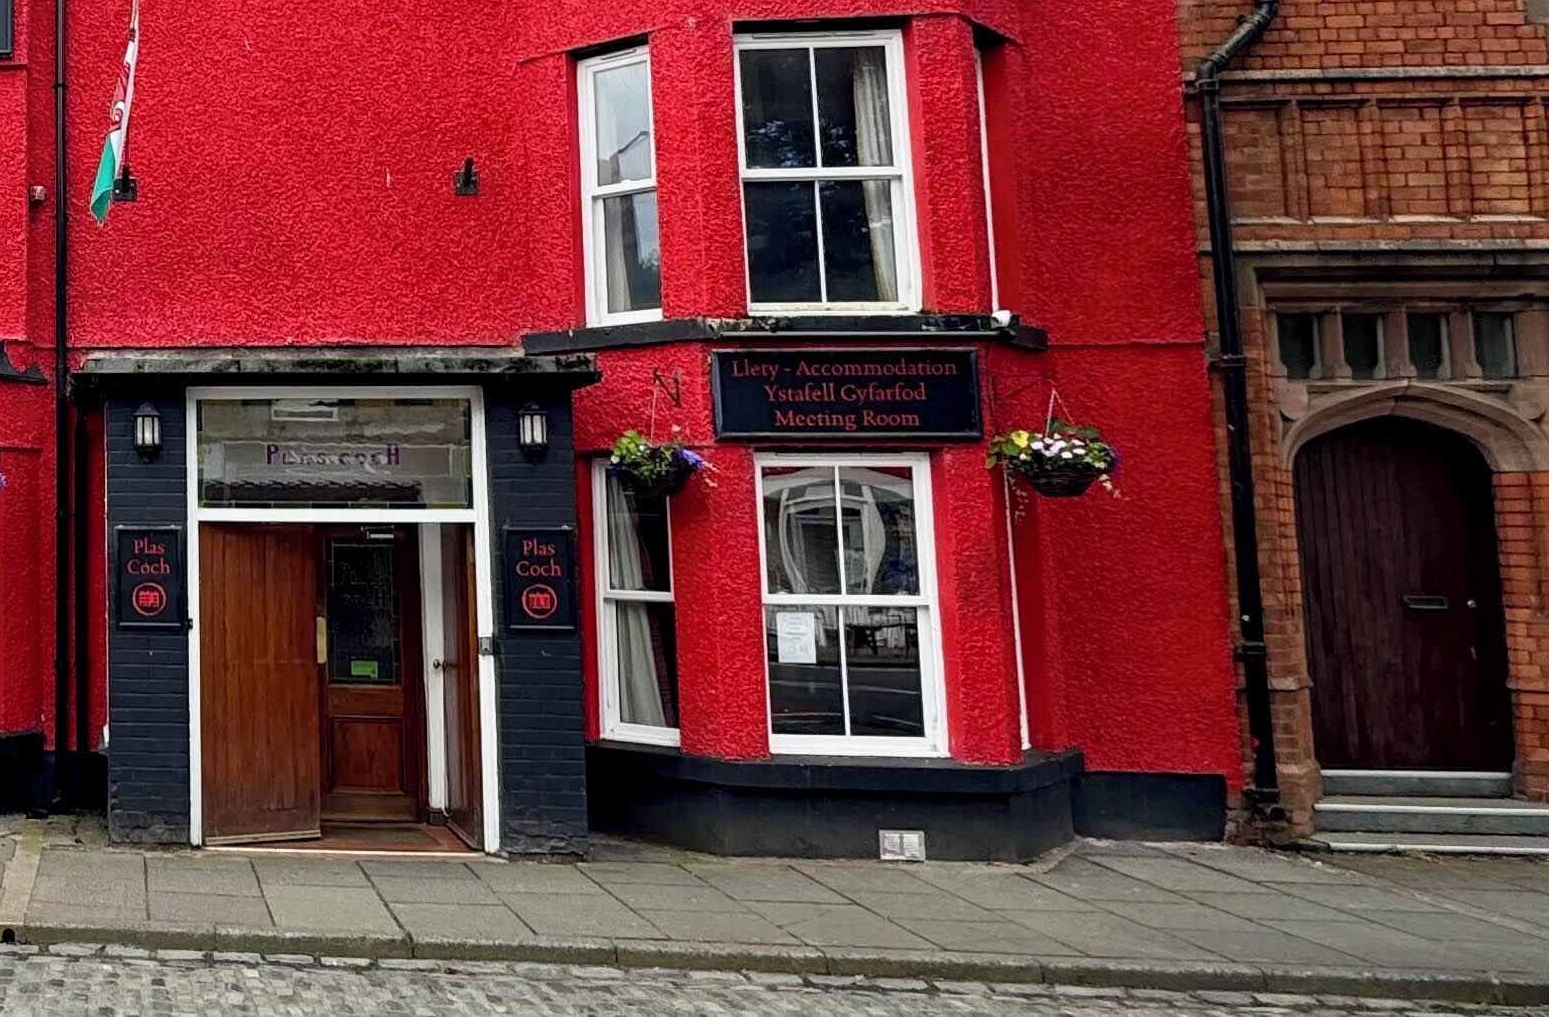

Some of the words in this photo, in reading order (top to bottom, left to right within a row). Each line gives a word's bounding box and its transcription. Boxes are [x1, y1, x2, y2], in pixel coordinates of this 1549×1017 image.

[730, 359, 780, 380] Llety
[795, 357, 958, 377] Accommodation
[763, 383, 836, 403] Ystafell
[841, 382, 928, 406] Gyfarfod
[773, 409, 857, 430] Meeting
[862, 409, 922, 427] Room
[132, 537, 165, 554] Plas
[522, 537, 556, 556] Plas
[126, 558, 171, 575] Coch
[515, 558, 563, 577] Coch
